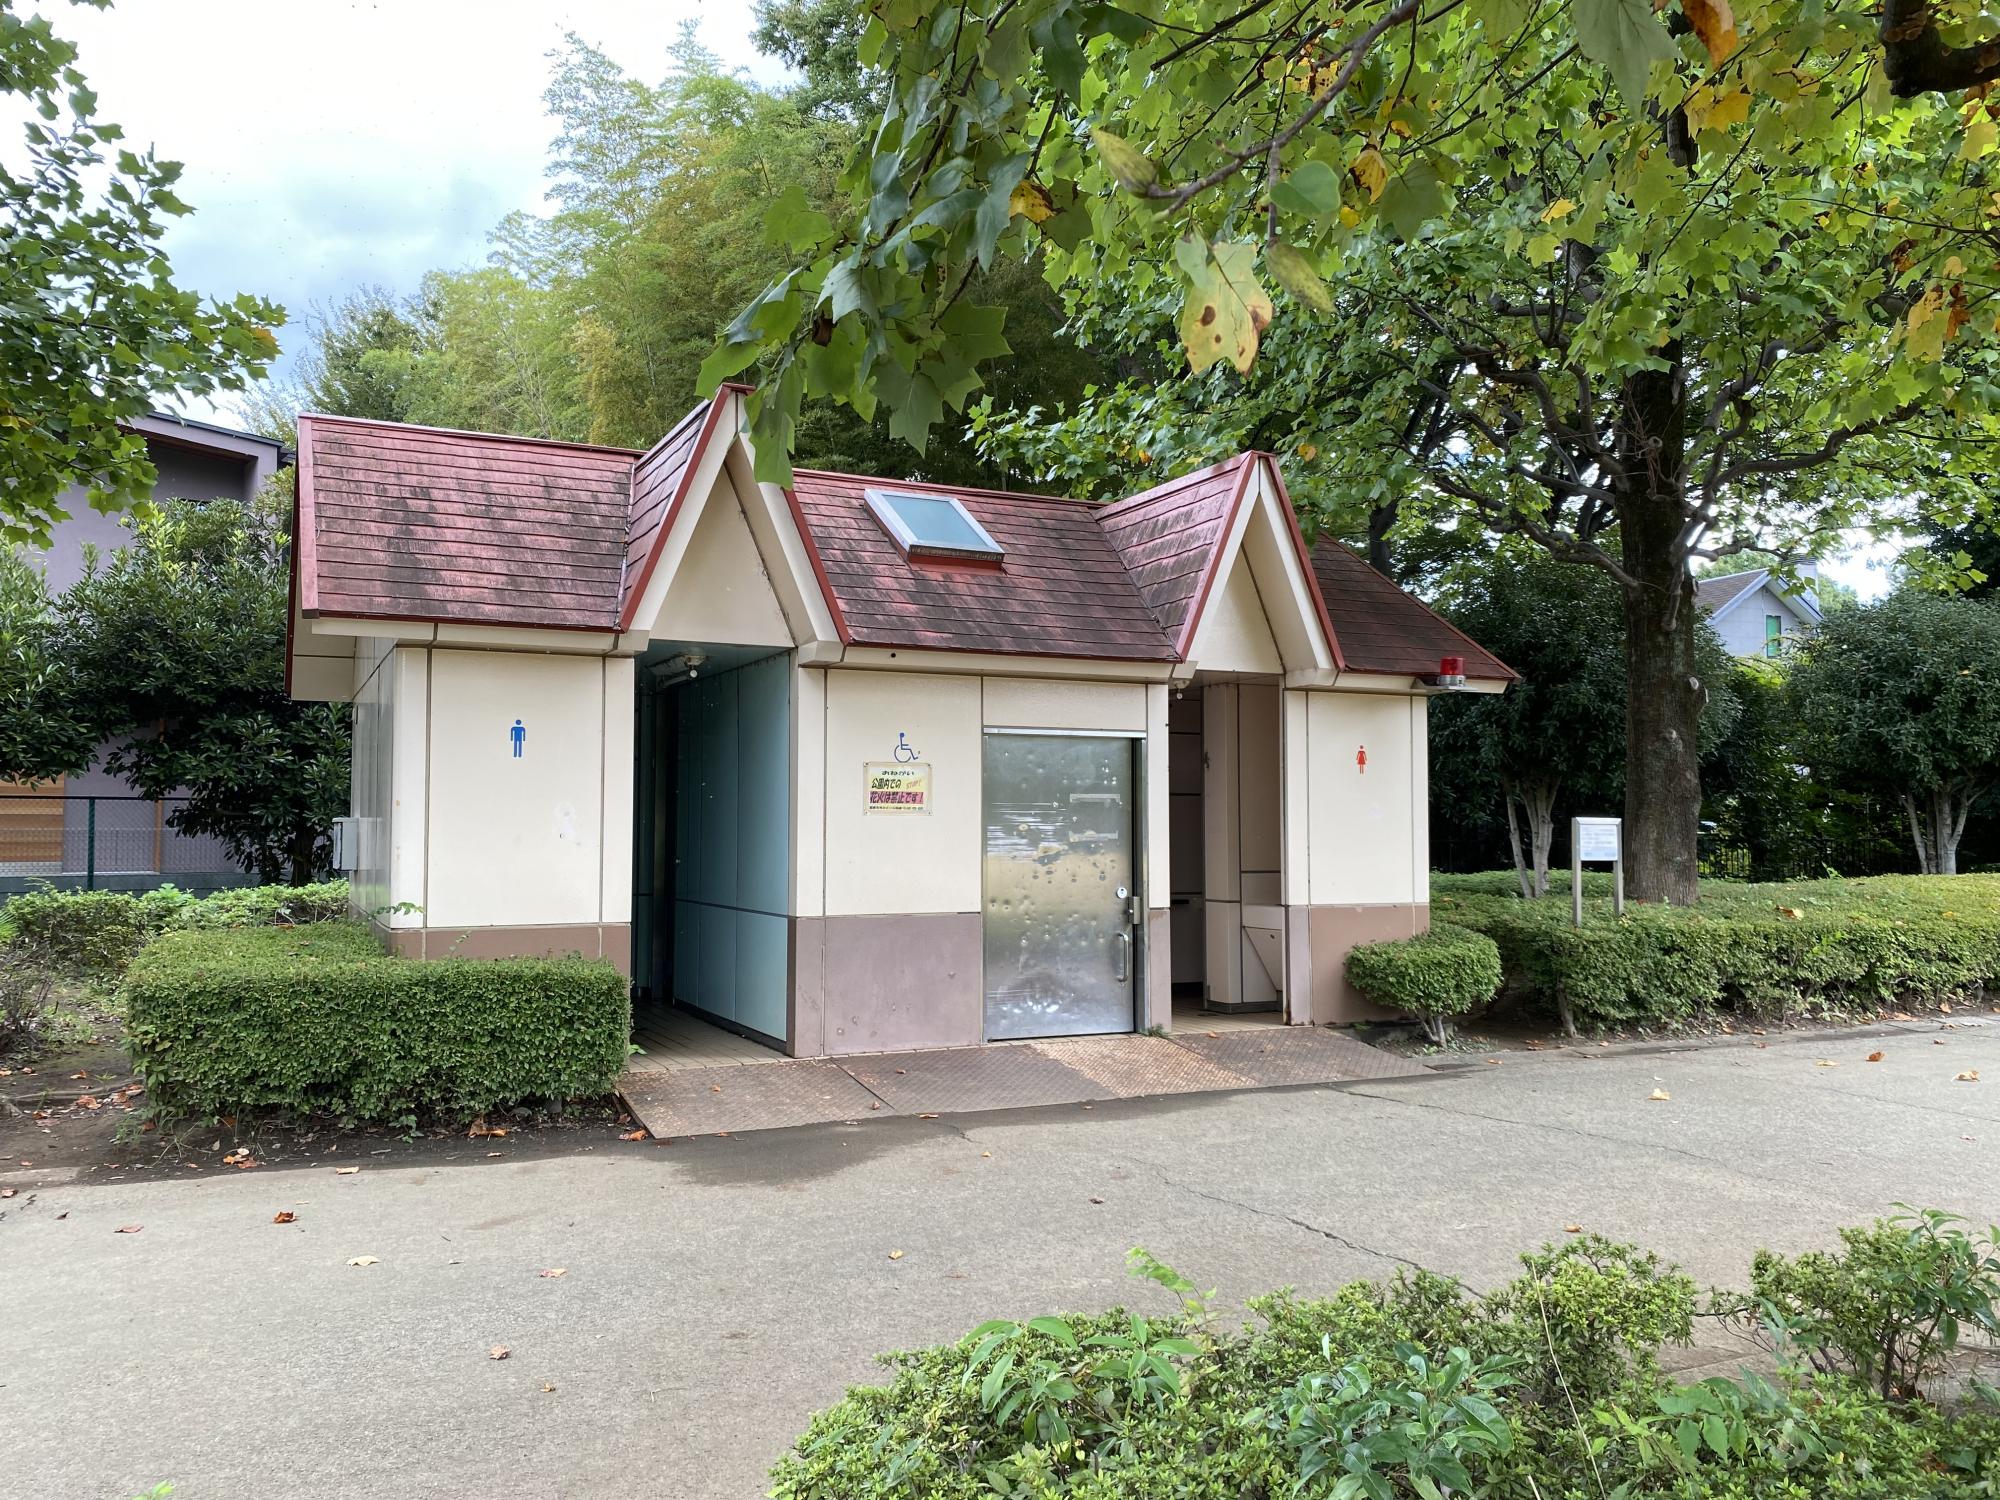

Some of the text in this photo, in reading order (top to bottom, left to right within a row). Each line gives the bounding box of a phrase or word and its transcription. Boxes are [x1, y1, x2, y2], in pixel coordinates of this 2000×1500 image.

[872, 778, 902, 790] 公園内での
